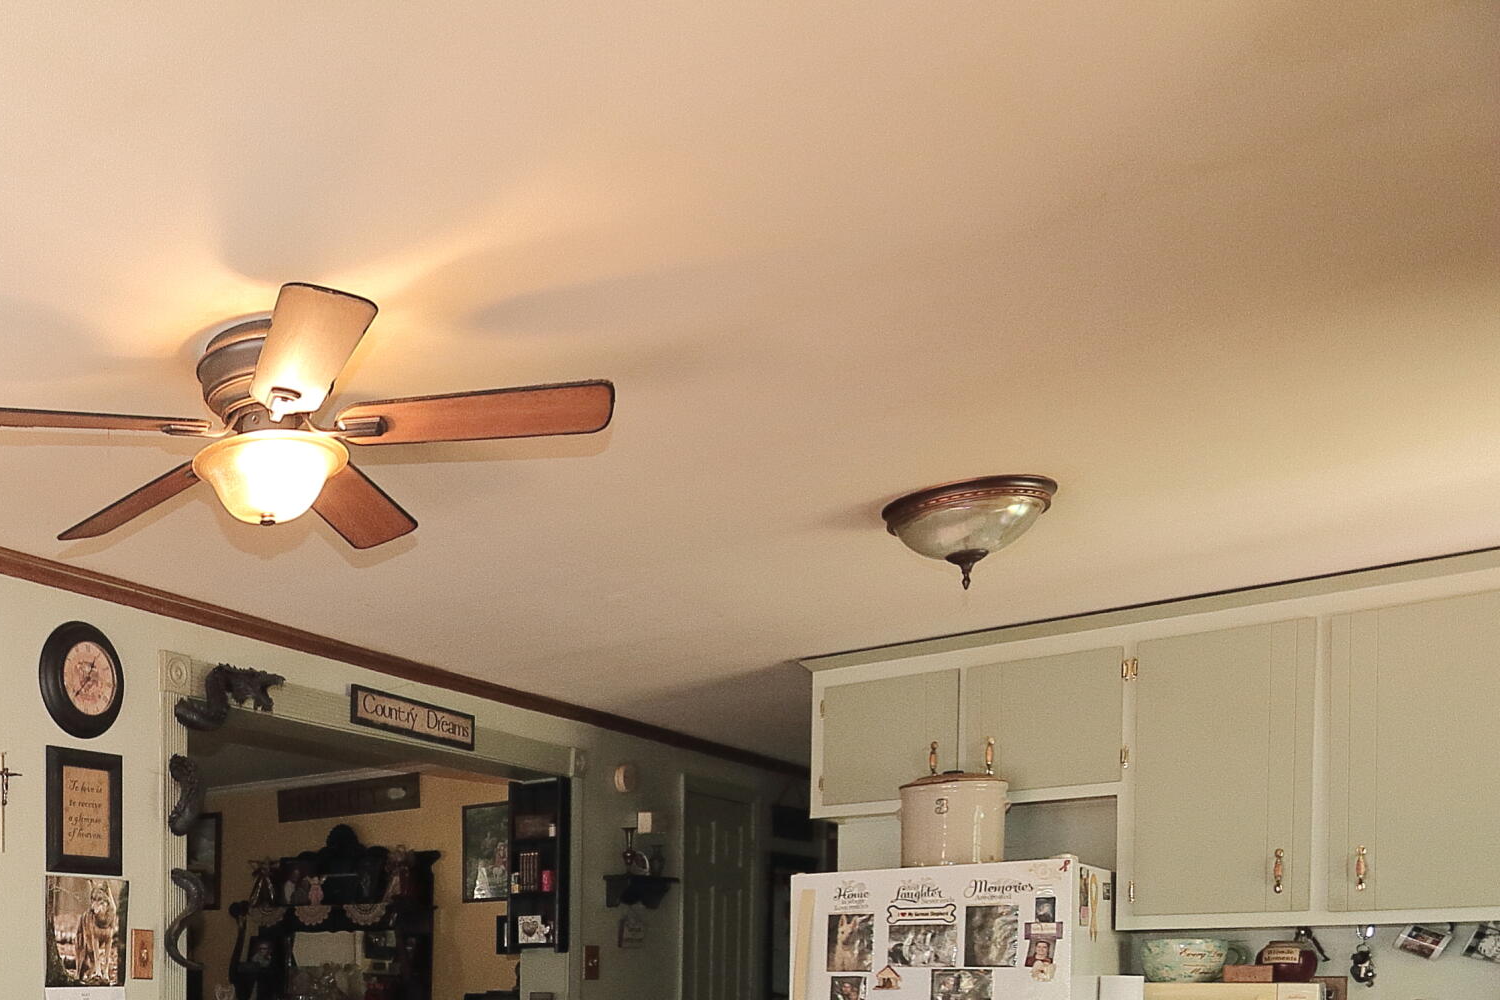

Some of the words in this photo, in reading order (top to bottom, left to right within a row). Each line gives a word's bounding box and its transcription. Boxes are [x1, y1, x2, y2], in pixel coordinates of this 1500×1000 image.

[363, 694, 418, 730] Country
[427, 709, 470, 738] Dreams
[833, 886, 870, 901] Home
[890, 884, 944, 904] Laughter
[963, 879, 1034, 898] Memories
